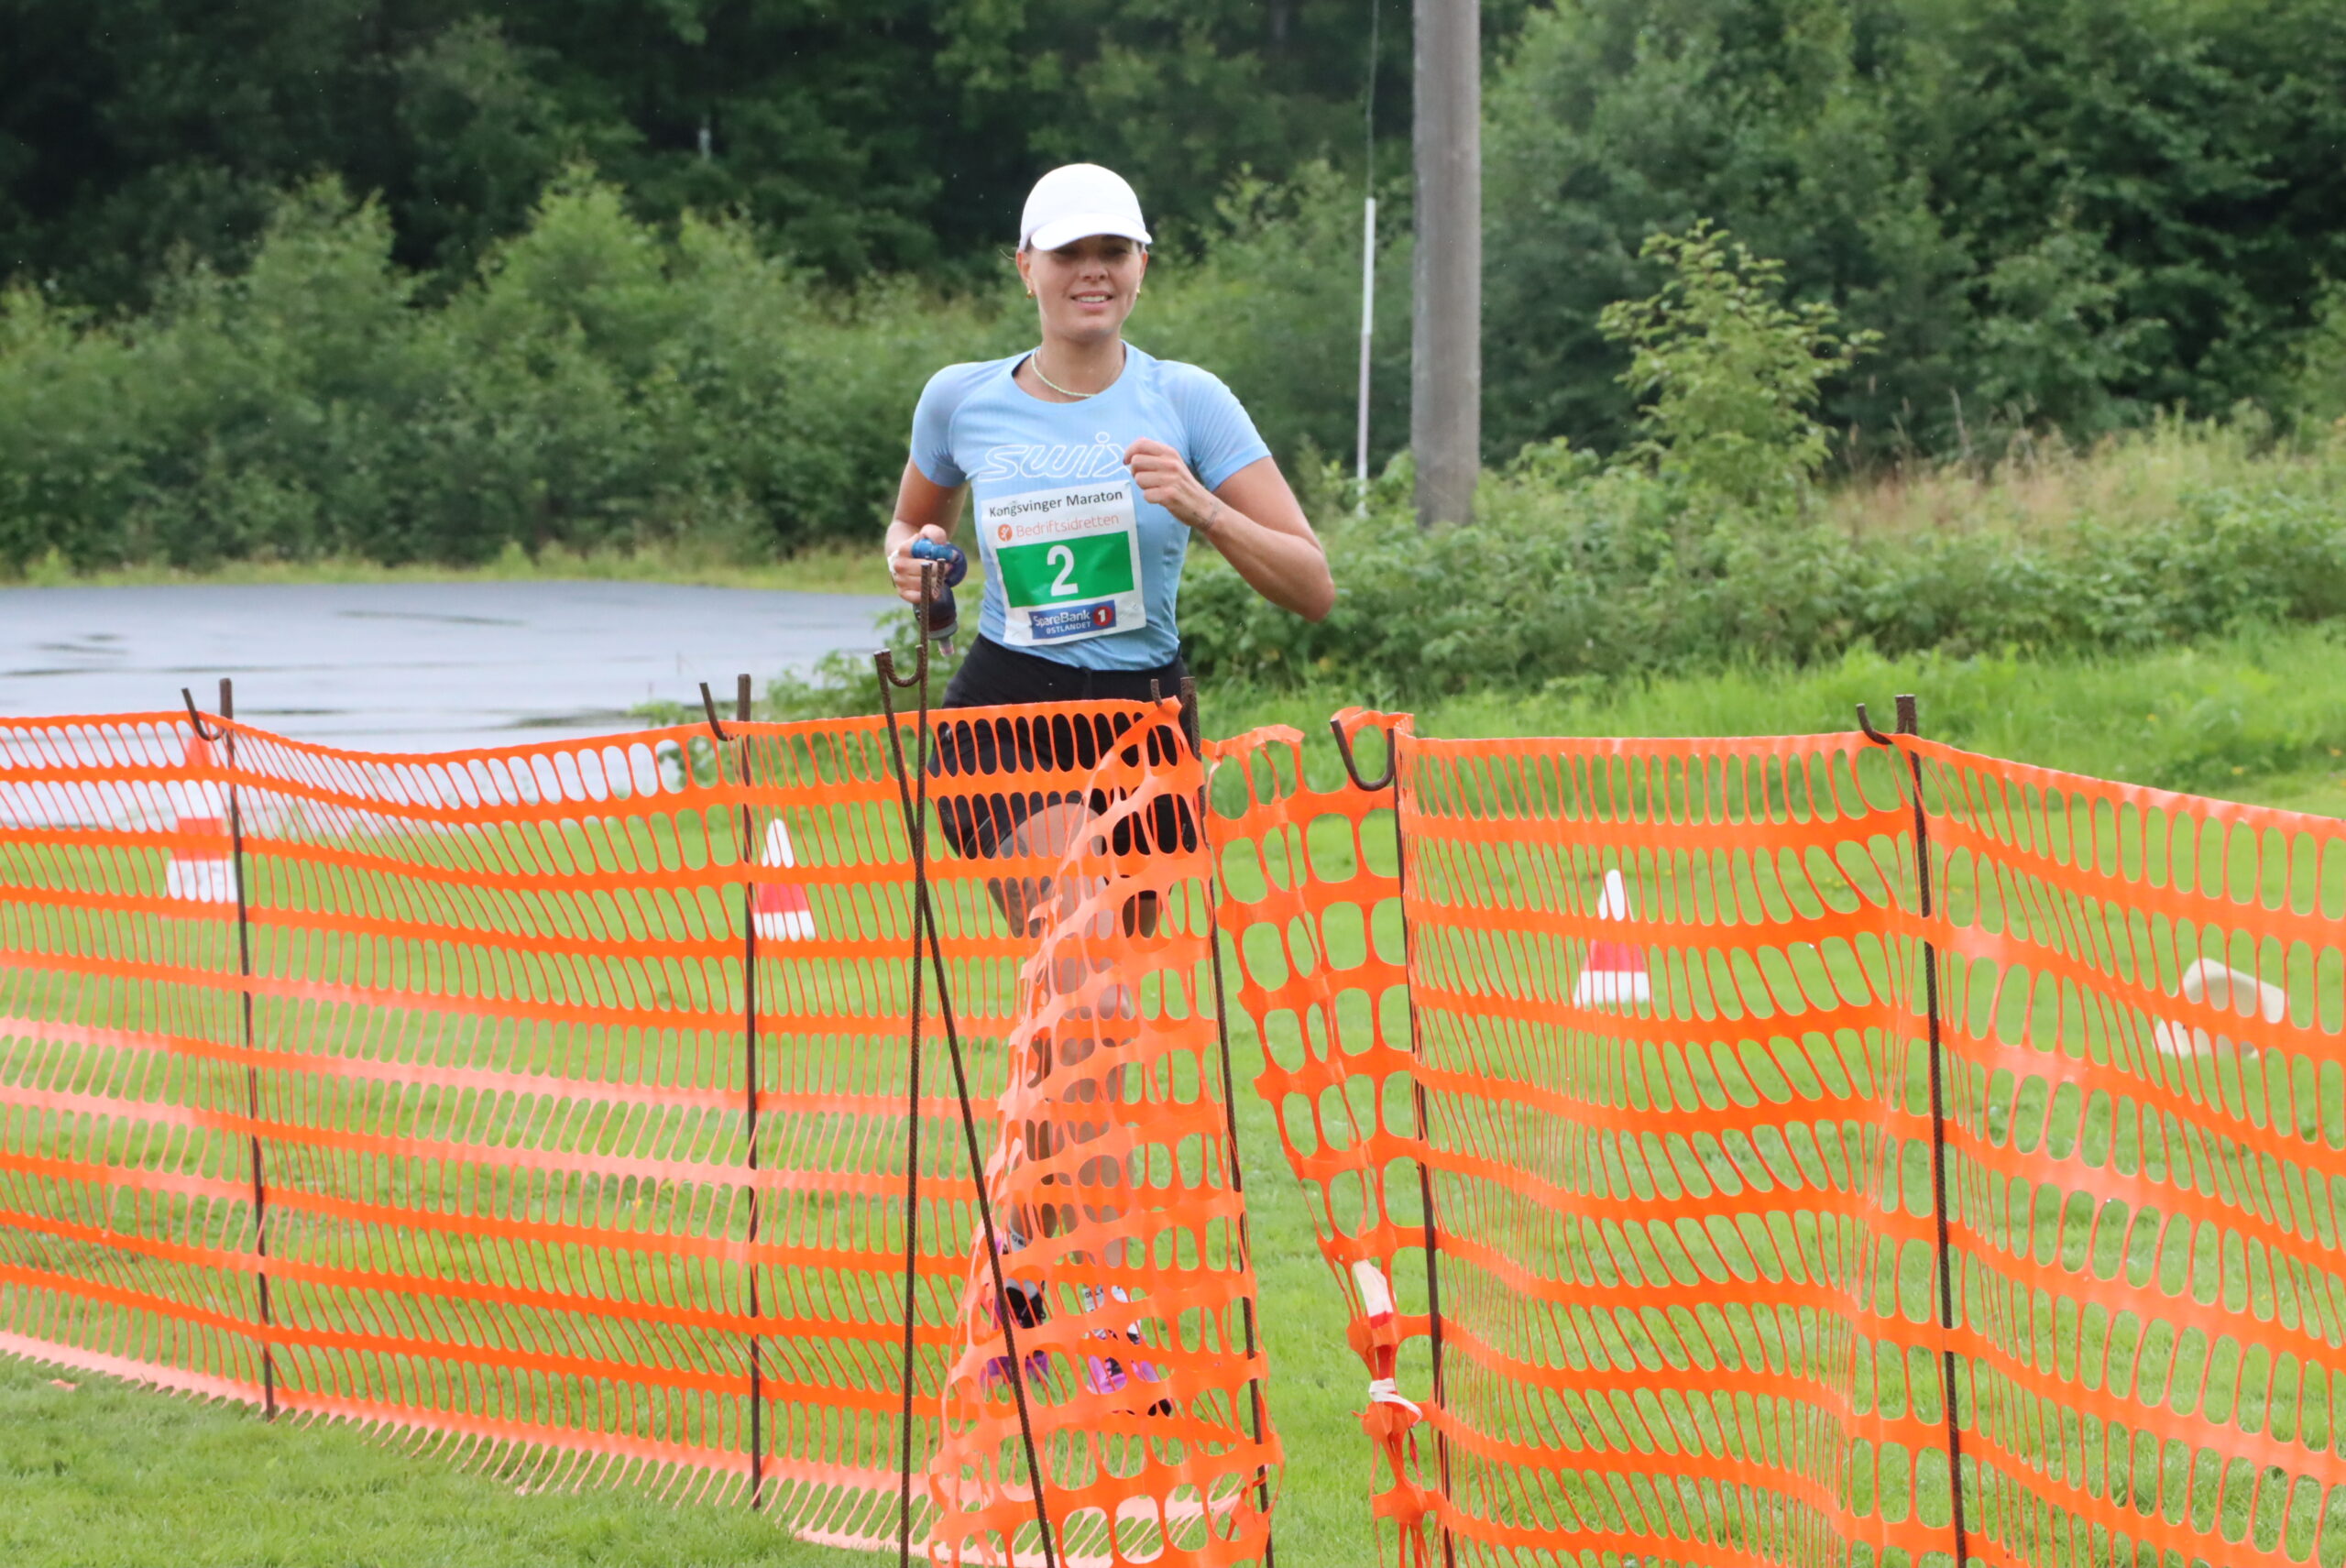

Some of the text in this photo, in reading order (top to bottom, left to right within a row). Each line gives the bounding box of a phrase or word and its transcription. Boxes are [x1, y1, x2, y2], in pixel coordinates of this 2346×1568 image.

[989, 490, 1124, 518] Kongsvinger Maraton
[1015, 514, 1120, 538] Bedriftsidretten
[1047, 544, 1079, 597] 2
[1033, 609, 1091, 629] SpareBank
